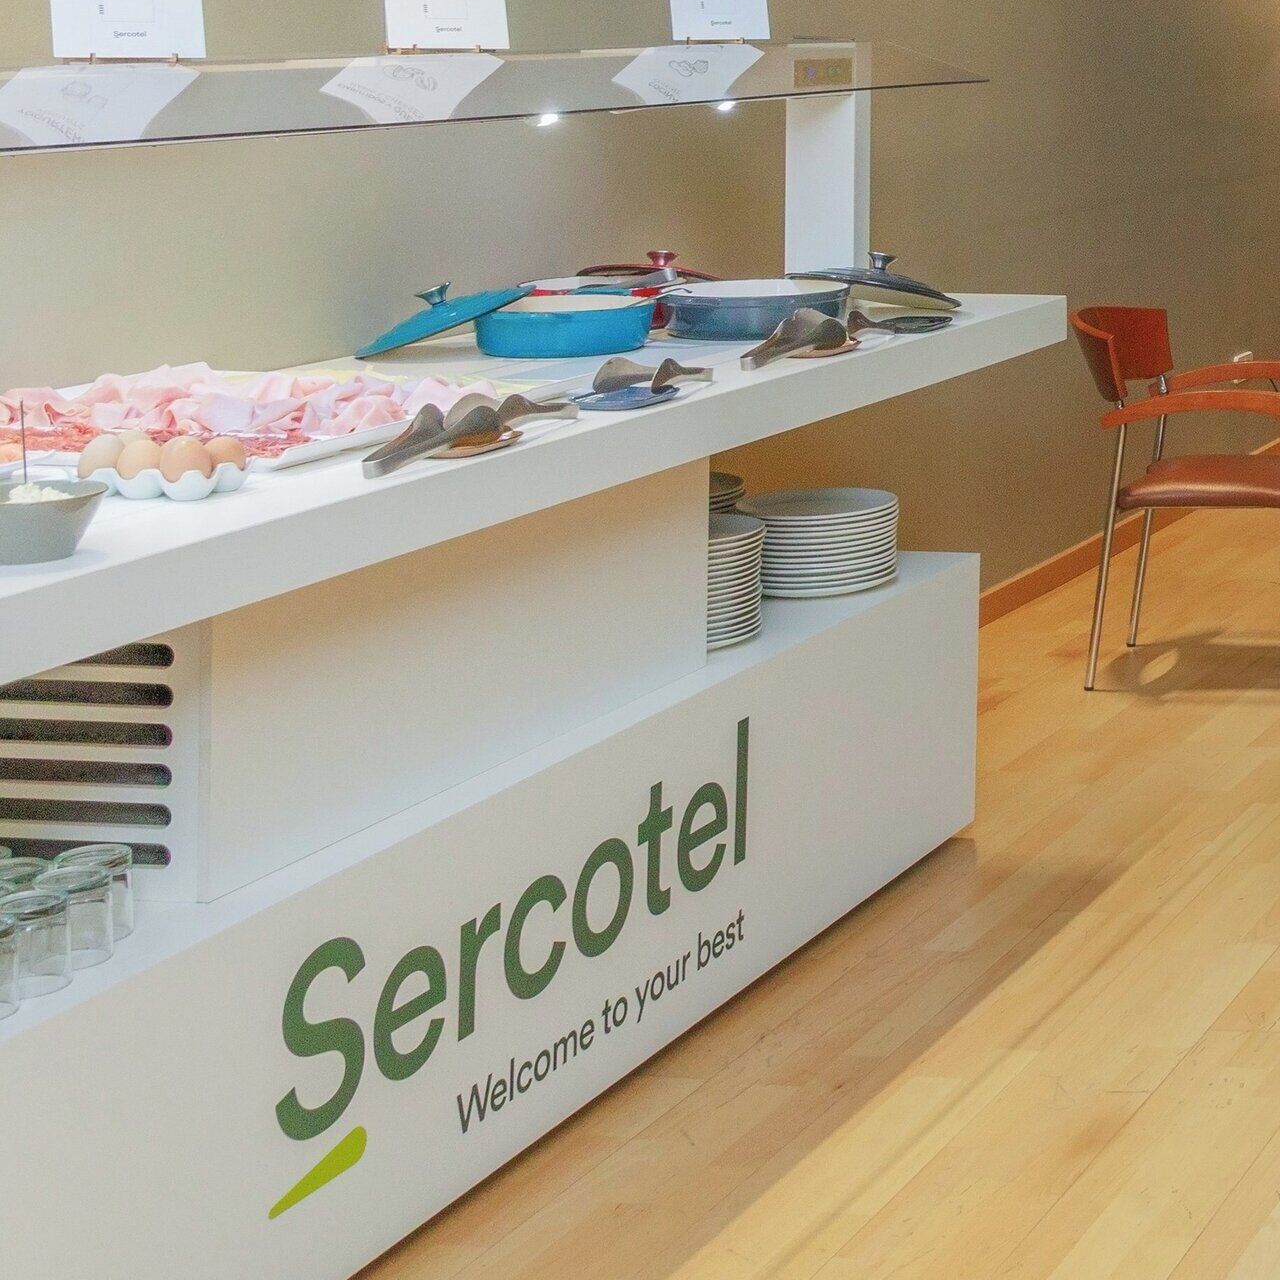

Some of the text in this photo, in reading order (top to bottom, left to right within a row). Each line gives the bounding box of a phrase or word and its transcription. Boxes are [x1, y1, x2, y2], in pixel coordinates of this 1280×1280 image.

[274, 716, 750, 1142] Sercotel
[456, 908, 745, 1135] Welcome to your best
